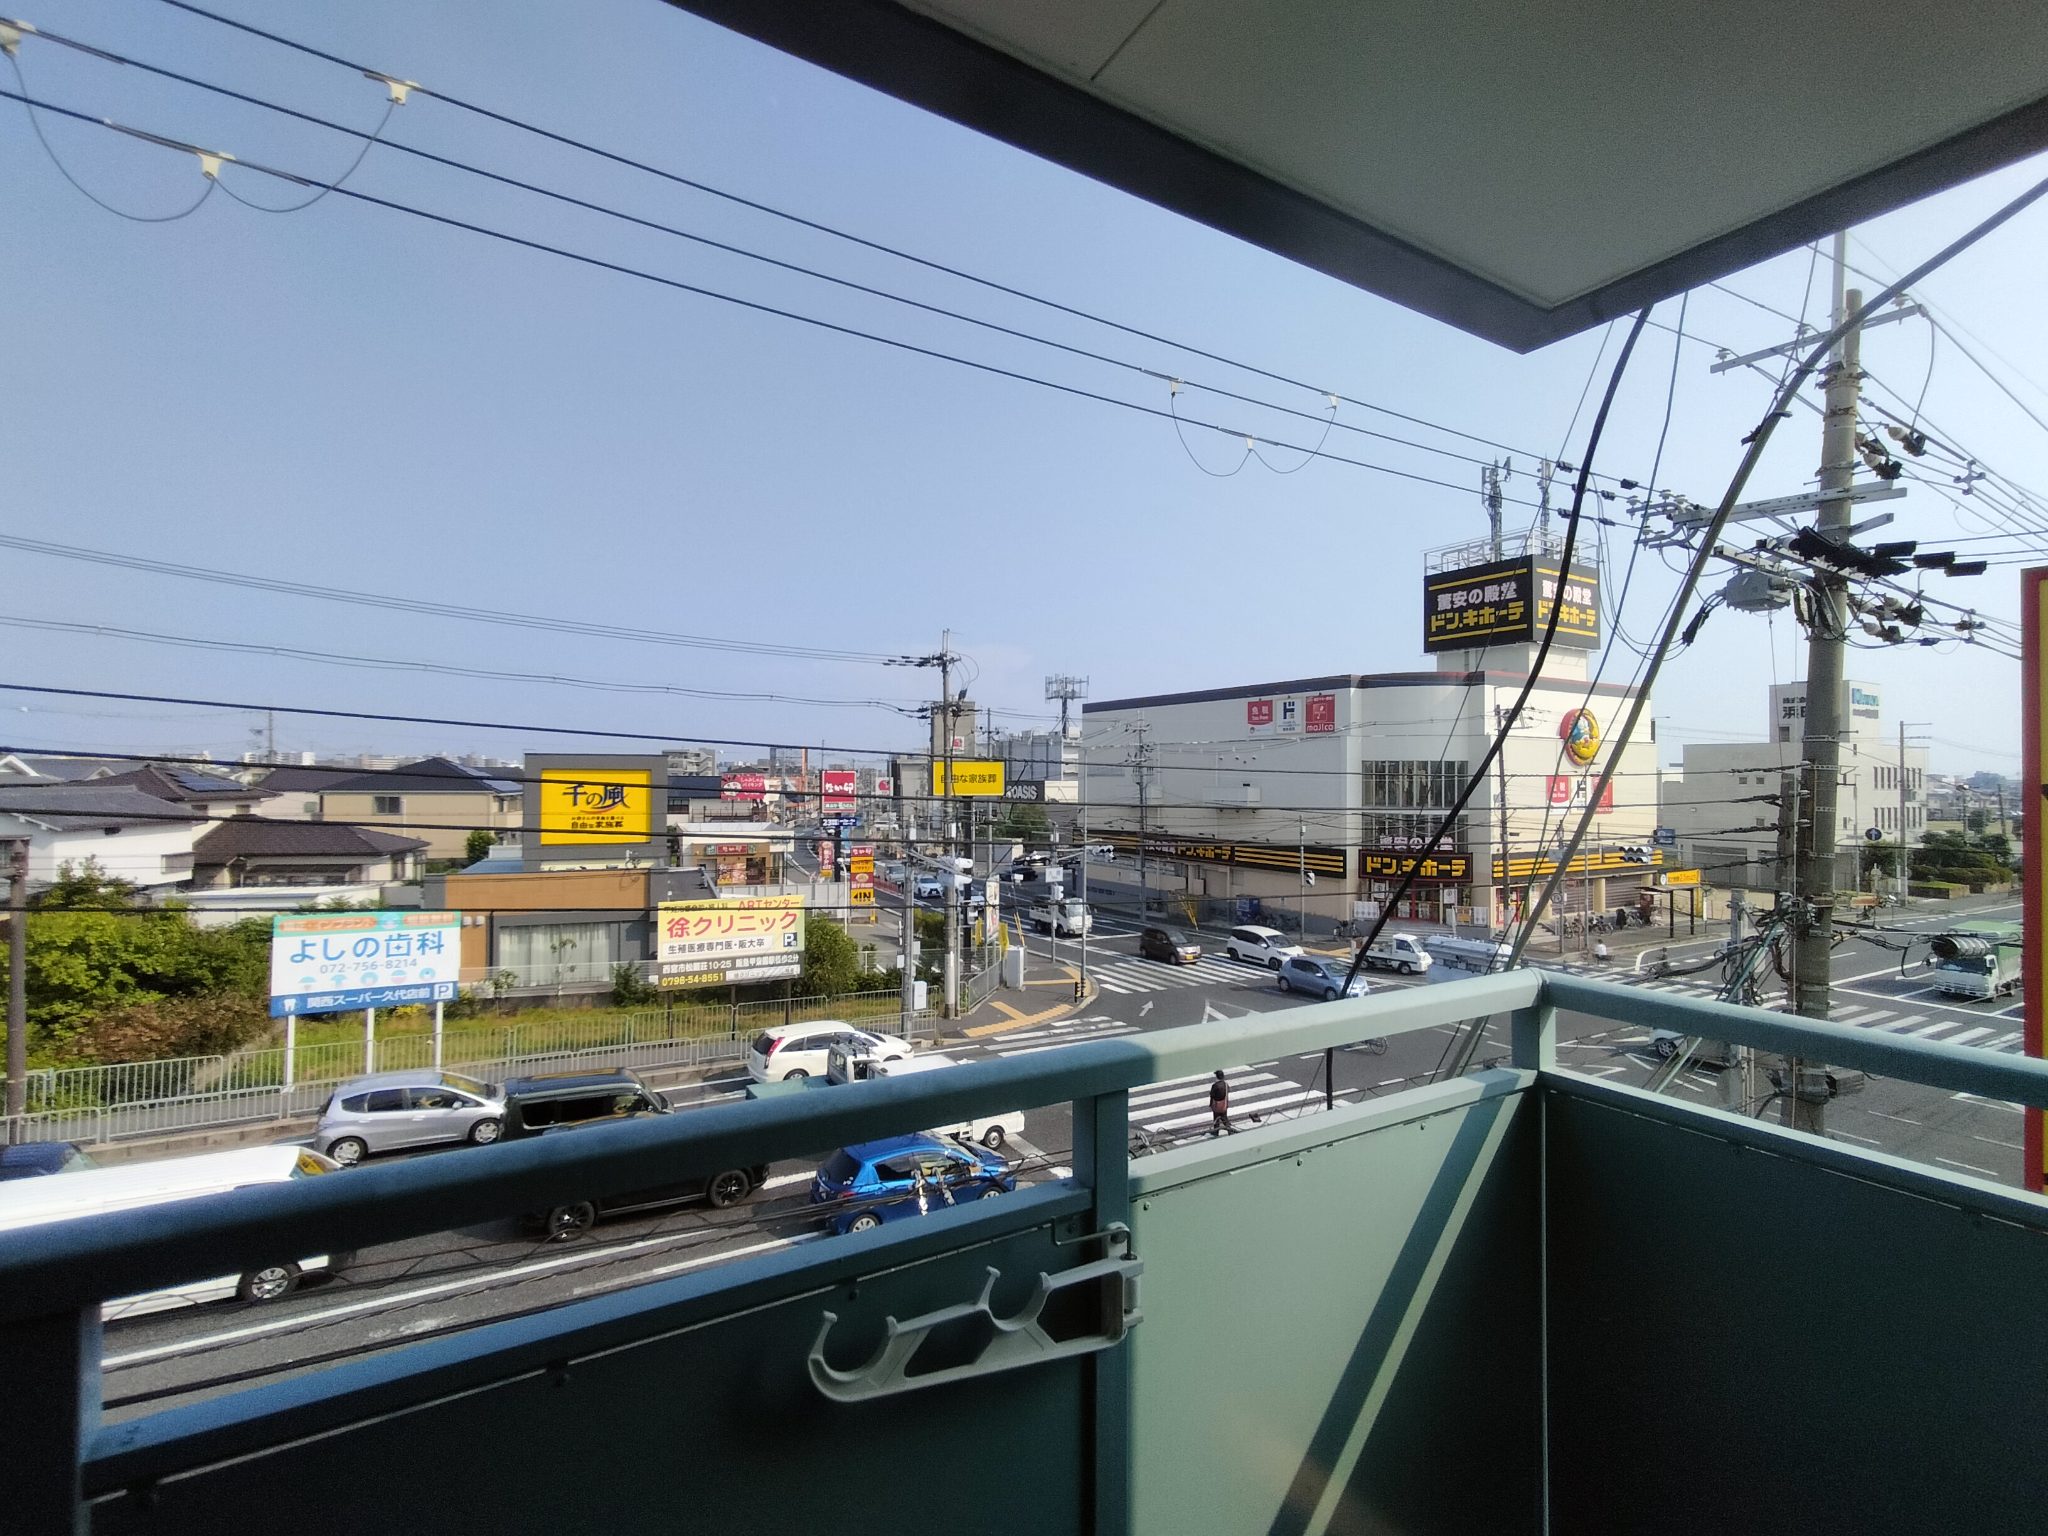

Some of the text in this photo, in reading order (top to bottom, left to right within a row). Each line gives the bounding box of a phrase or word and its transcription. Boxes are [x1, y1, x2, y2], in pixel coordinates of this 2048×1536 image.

[561, 784, 631, 809] 千の風
[666, 911, 798, 938] 徐クリニック
[289, 930, 445, 964] よしの歯科
[319, 958, 418, 974] 072-756-8214
[662, 972, 724, 987] 0798-54-8551
[306, 987, 431, 1009] 関西スーパー久代店前
